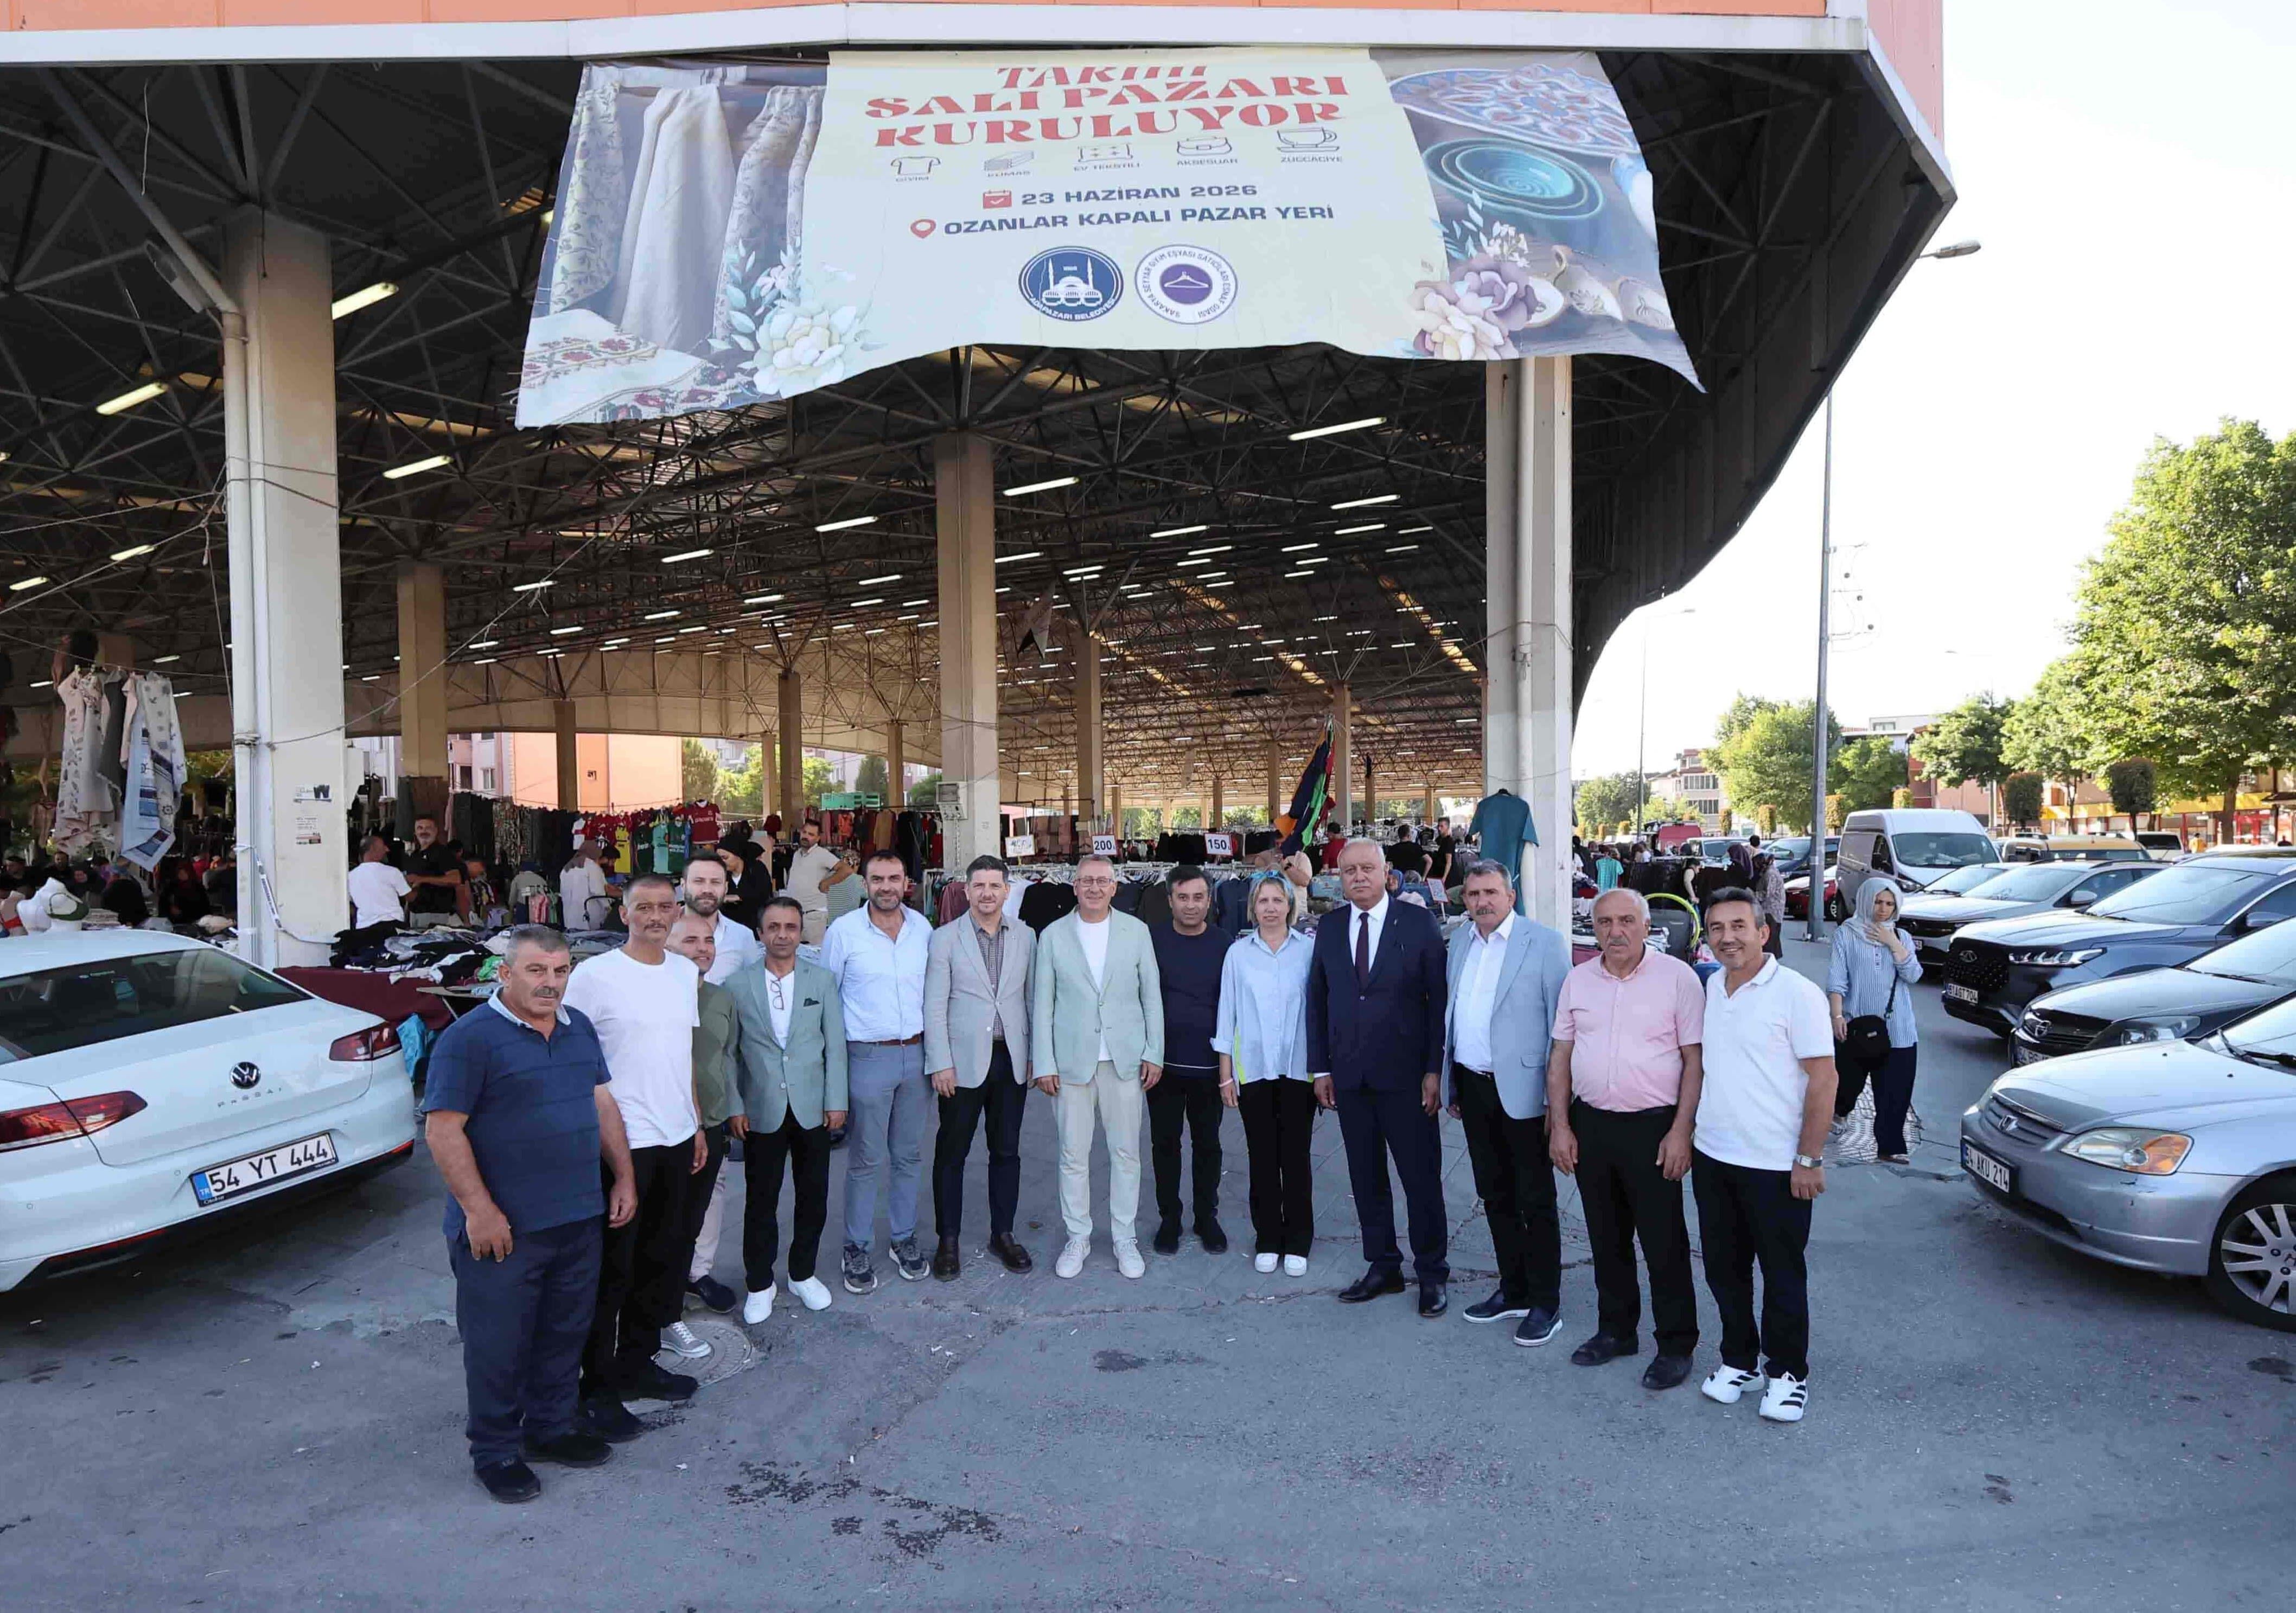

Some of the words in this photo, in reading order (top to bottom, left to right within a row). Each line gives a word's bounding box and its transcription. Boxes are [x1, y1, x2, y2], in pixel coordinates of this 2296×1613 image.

[865, 91, 1039, 118] SALI
[1063, 76, 1349, 108] PAZARI
[875, 103, 1346, 147] KURULUYOR
[1021, 193, 1055, 206] 23
[1065, 186, 1180, 203] HAZİRAN
[1190, 185, 1258, 197] 2026
[944, 215, 1068, 235] OZANLAR
[1079, 209, 1171, 226] KAPALI
[1181, 206, 1267, 222] PAZAR
[1274, 204, 1334, 220] YERİ
[209, 1168, 240, 1193] 54
[248, 1154, 277, 1179] YT
[290, 1140, 328, 1166] 444
[1993, 1164, 2008, 1190] 214
